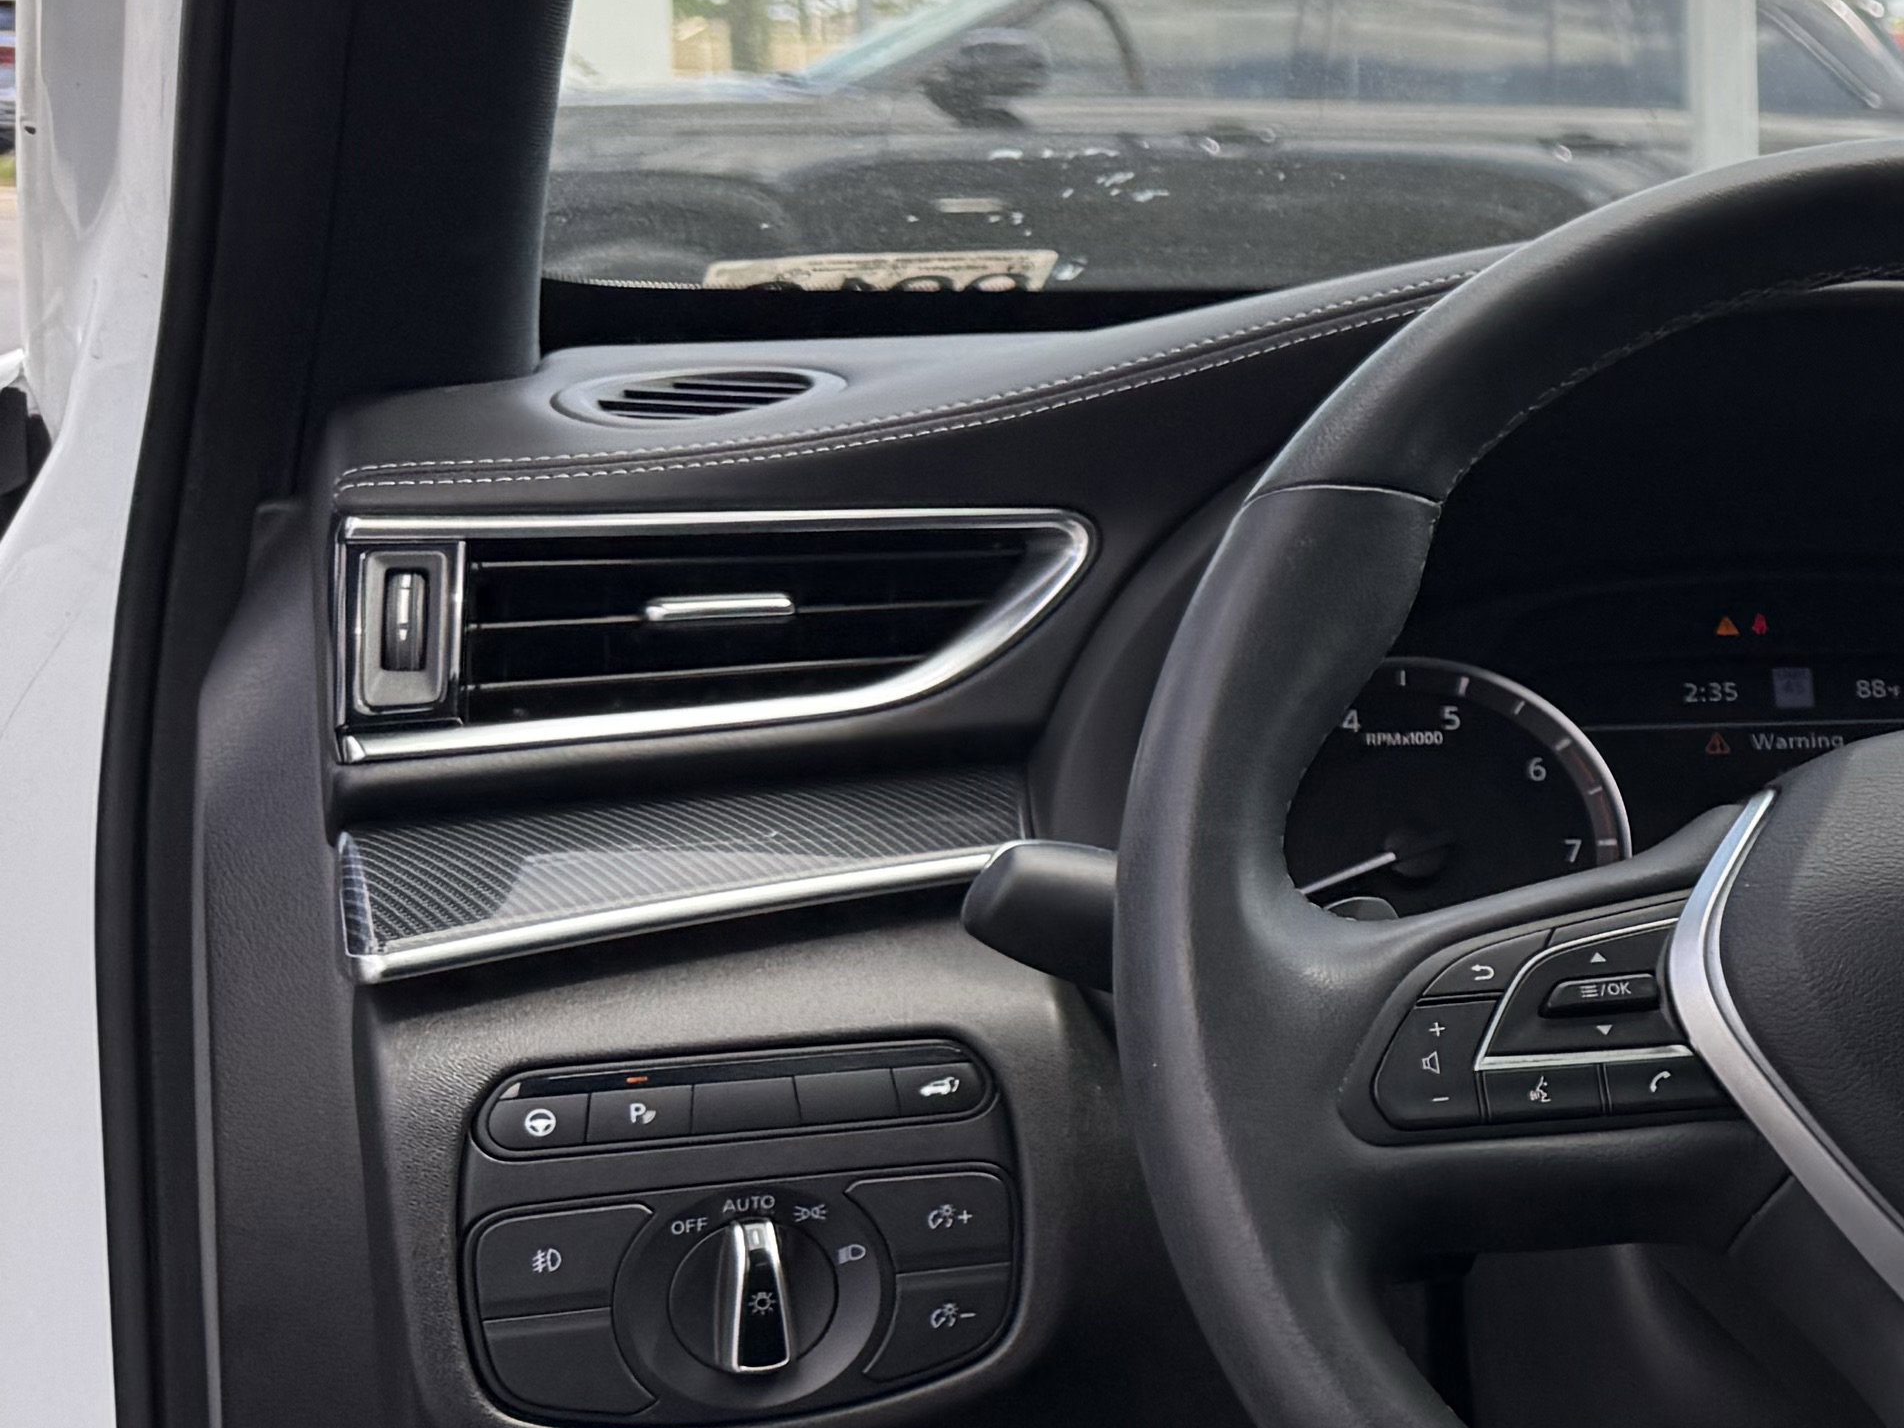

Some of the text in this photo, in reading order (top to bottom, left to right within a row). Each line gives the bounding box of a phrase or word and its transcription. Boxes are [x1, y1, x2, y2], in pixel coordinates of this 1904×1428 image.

[1684, 682, 1738, 703] 2:35
[1342, 709, 1361, 732] 4
[1443, 706, 1461, 730] 5
[1751, 731, 1845, 751] Warning
[1527, 757, 1547, 781] 6
[1564, 838, 1582, 862] 7
[722, 1195, 776, 1213] AUTO
[671, 1217, 708, 1235] OFF
